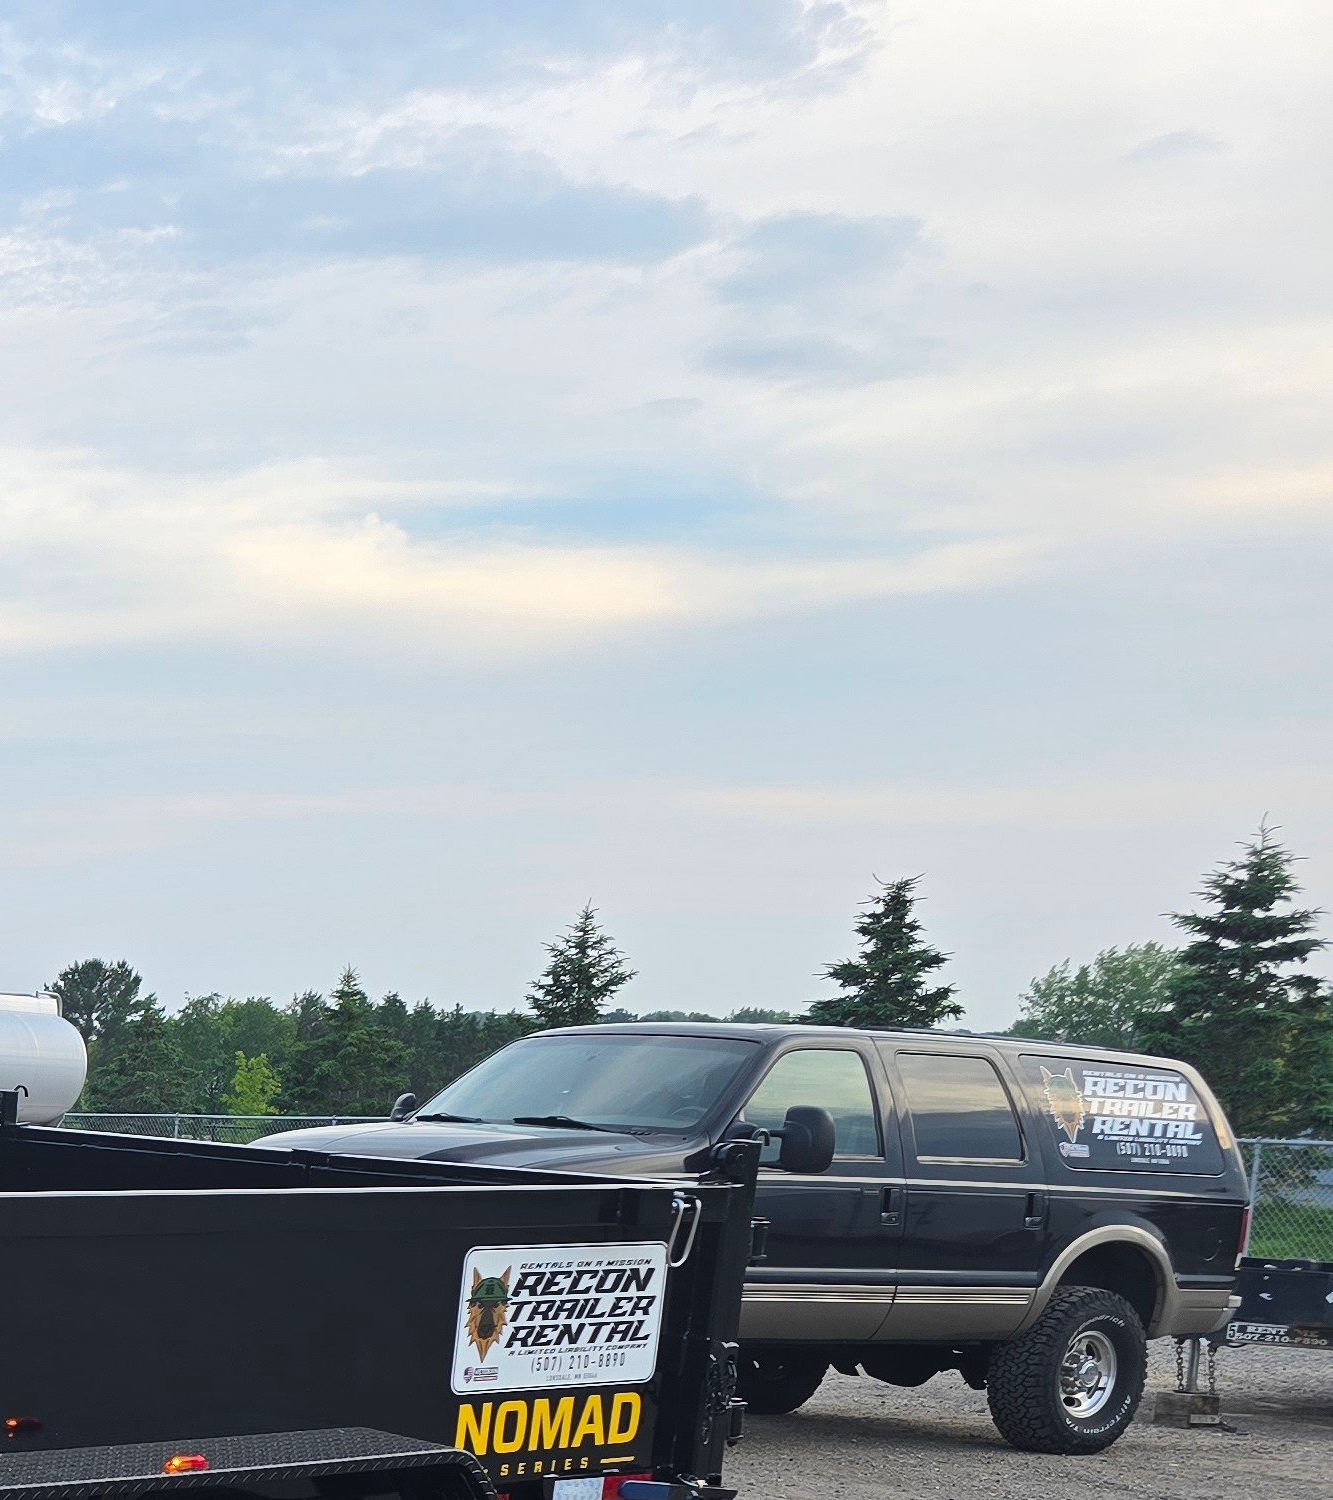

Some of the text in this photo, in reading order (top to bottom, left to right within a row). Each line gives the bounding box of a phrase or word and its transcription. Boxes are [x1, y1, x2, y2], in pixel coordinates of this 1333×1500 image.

[1083, 1076, 1187, 1101] RECON
[1085, 1097, 1197, 1120] TRAILER
[1092, 1116, 1203, 1139] RENTAL
[520, 1261, 574, 1270] RENTALS
[606, 1258, 652, 1267] MISSION
[511, 1268, 656, 1297] RECON
[509, 1295, 657, 1322] TRAILER
[504, 1319, 652, 1348] RENTAL
[1246, 1326, 1288, 1335] RENT
[531, 1352, 626, 1373] (507) 210-8890
[455, 1392, 641, 1456] NOMAD
[500, 1456, 589, 1476] SERIES
